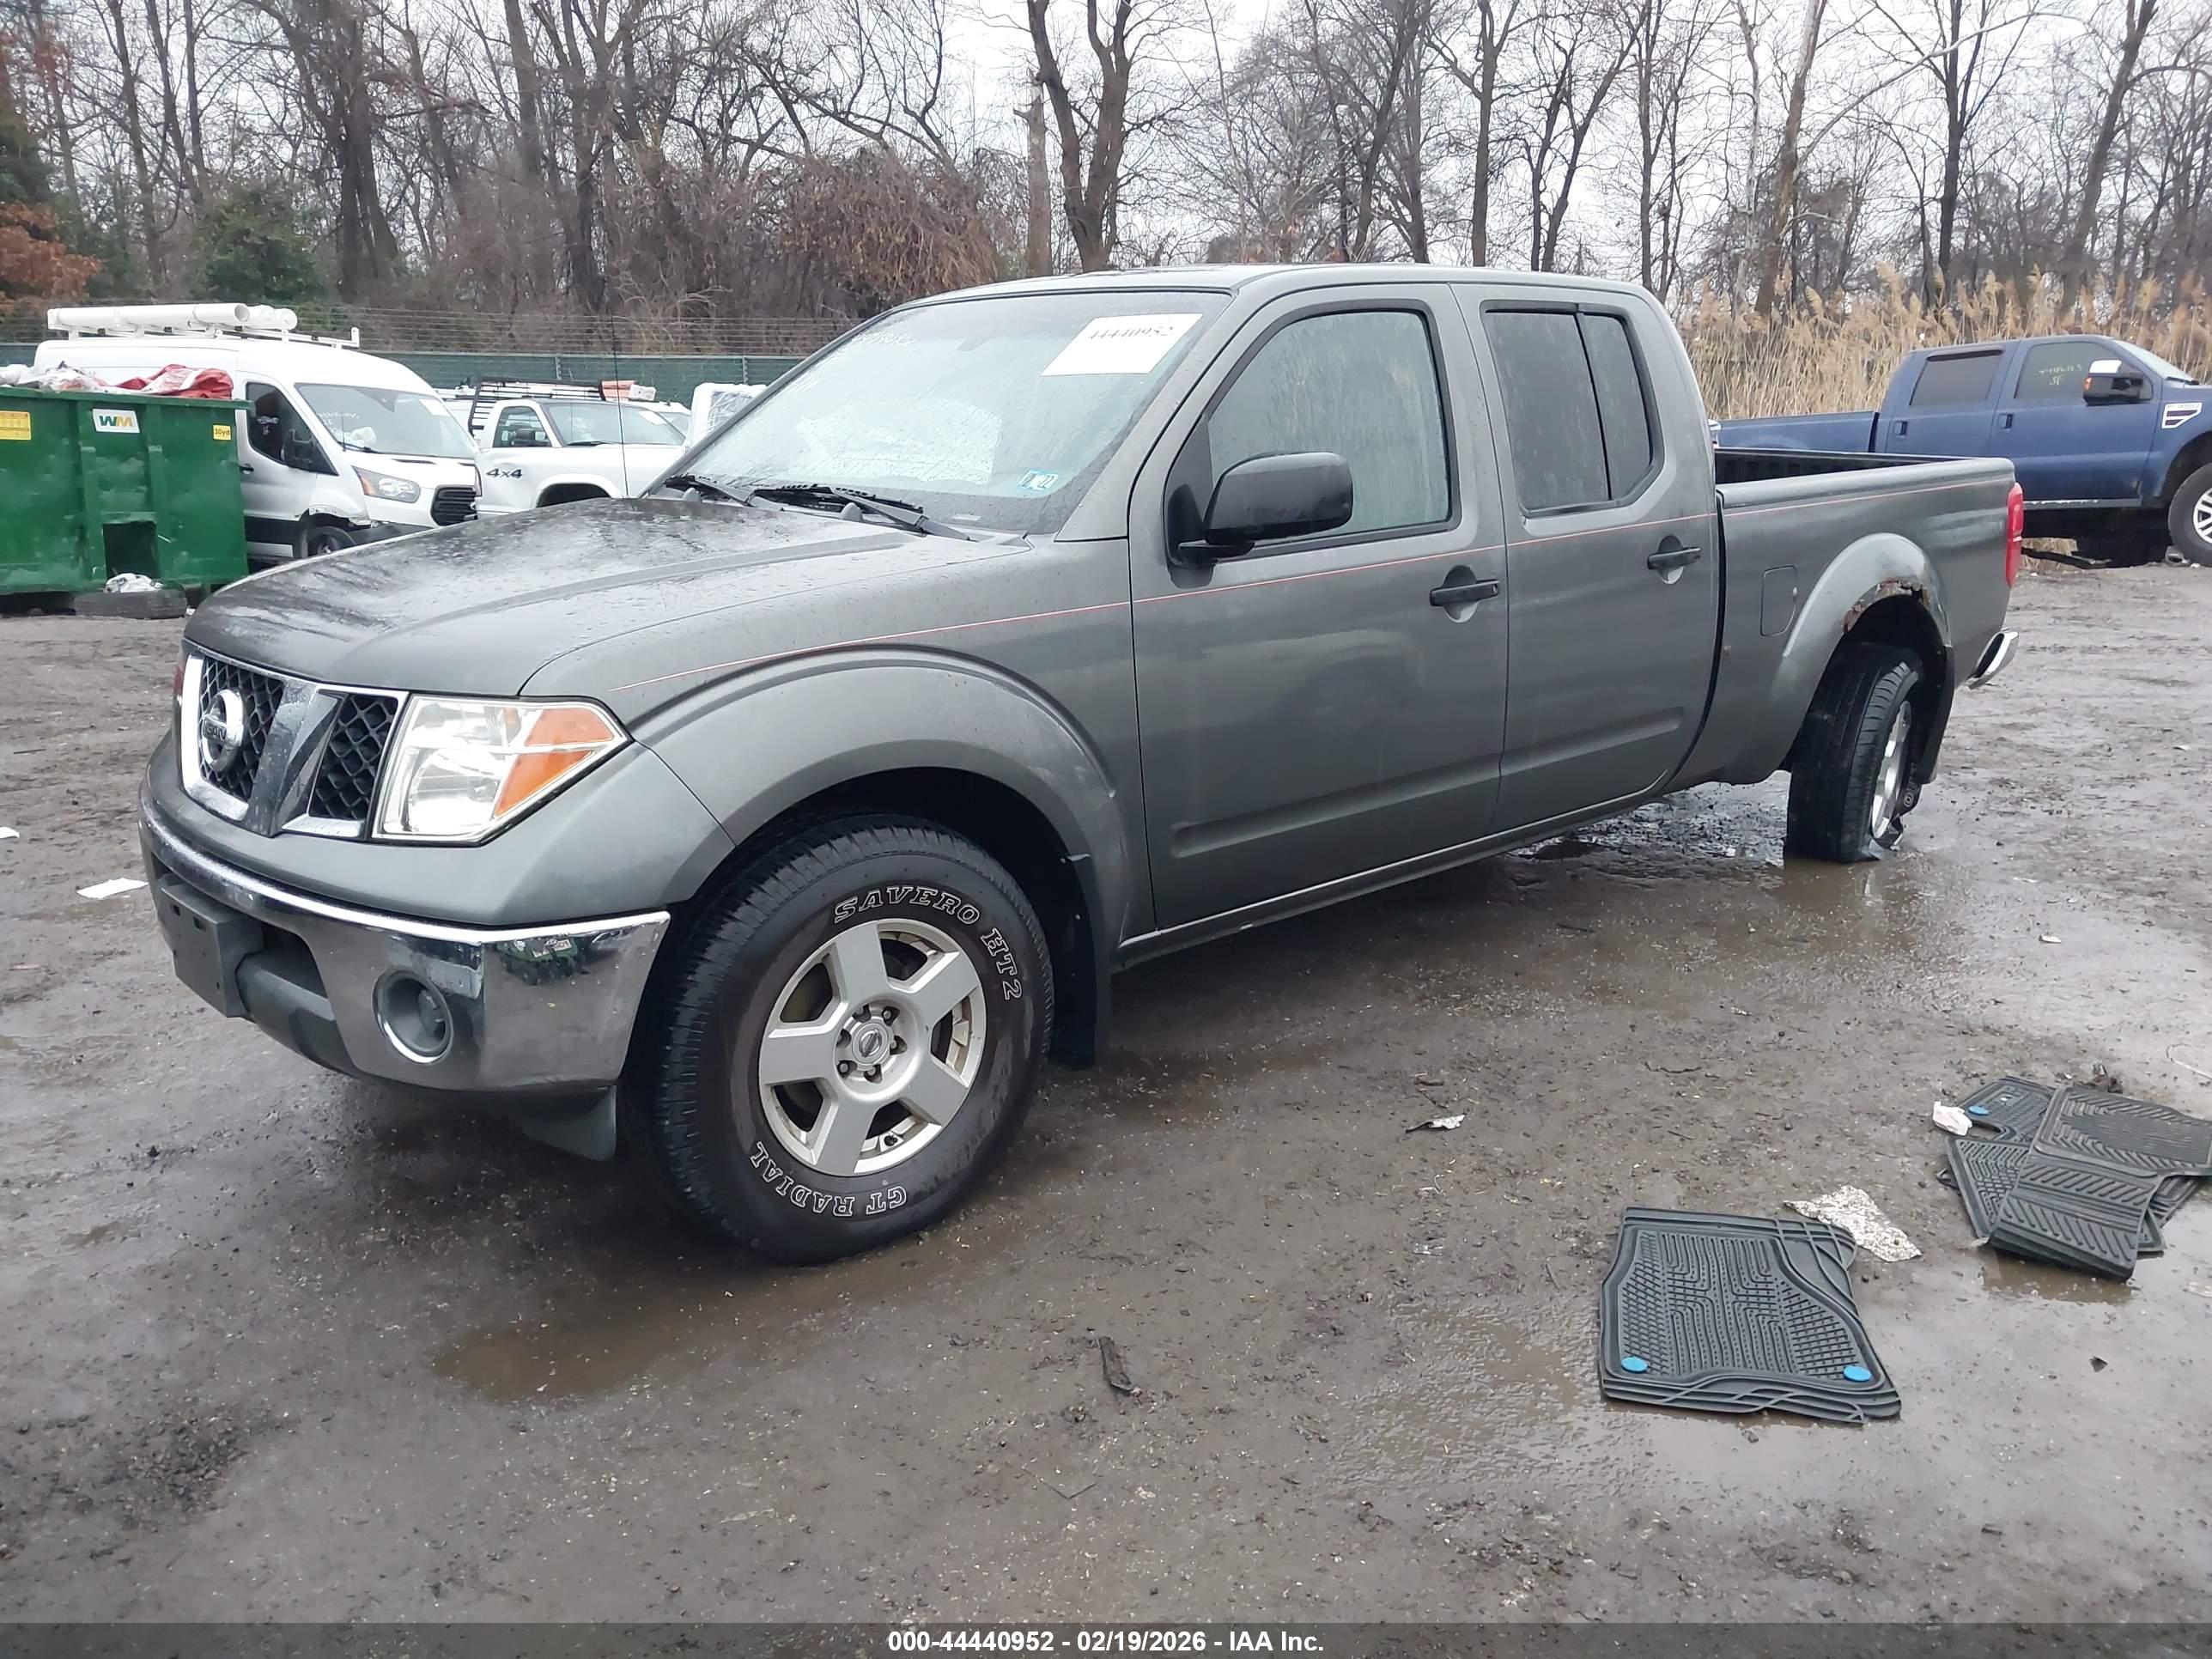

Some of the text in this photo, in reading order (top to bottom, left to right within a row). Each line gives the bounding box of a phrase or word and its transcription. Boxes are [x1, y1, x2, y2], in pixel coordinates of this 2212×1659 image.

[99, 415, 133, 427] WM
[486, 468, 523, 478] 4x4
[834, 885, 1022, 1000] SAVERO HT2
[750, 1141, 907, 1216] GT RADIAL
